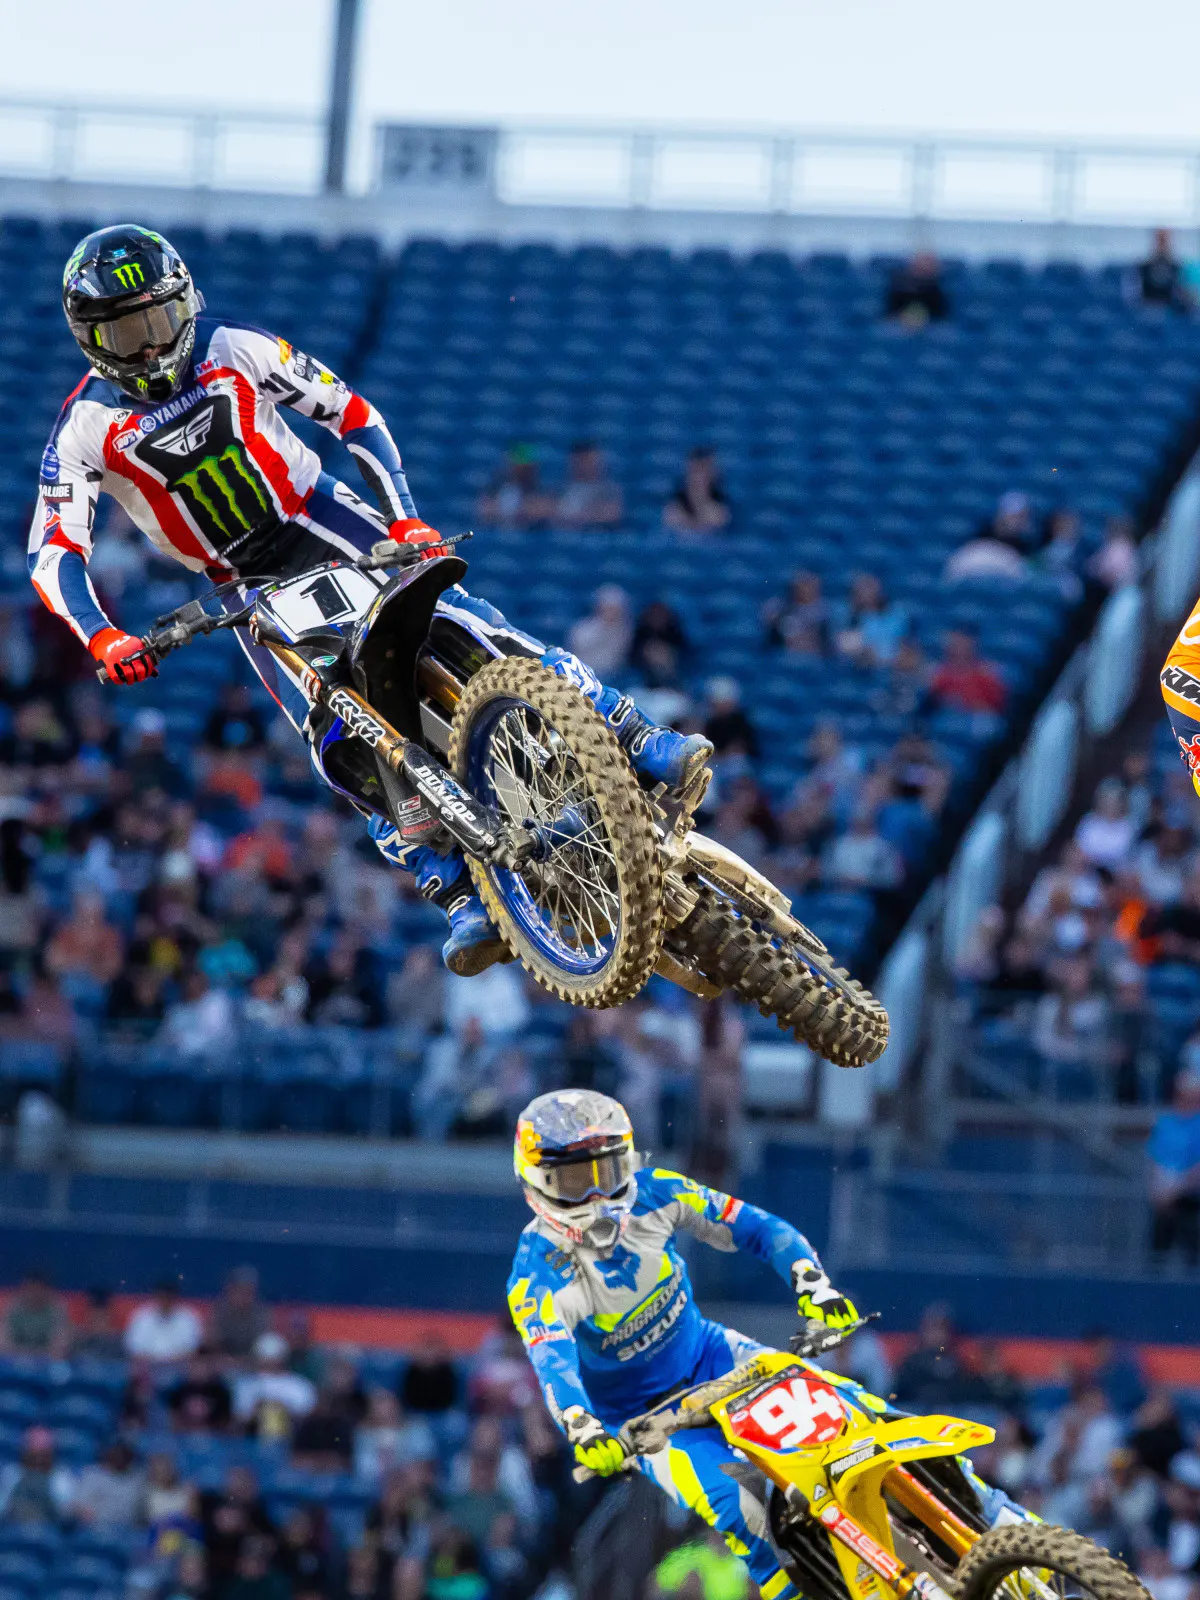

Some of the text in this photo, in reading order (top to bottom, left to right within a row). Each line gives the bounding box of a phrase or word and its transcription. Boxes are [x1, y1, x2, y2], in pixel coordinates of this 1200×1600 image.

[153, 385, 208, 425] YAMAHA
[40, 485, 70, 498] ALUBE
[299, 571, 356, 623] 1
[415, 765, 477, 822] DUNLOP
[616, 1290, 687, 1361] SUZUKI
[750, 1377, 844, 1449] 94
[830, 1445, 876, 1477] PROGRESSIVE
